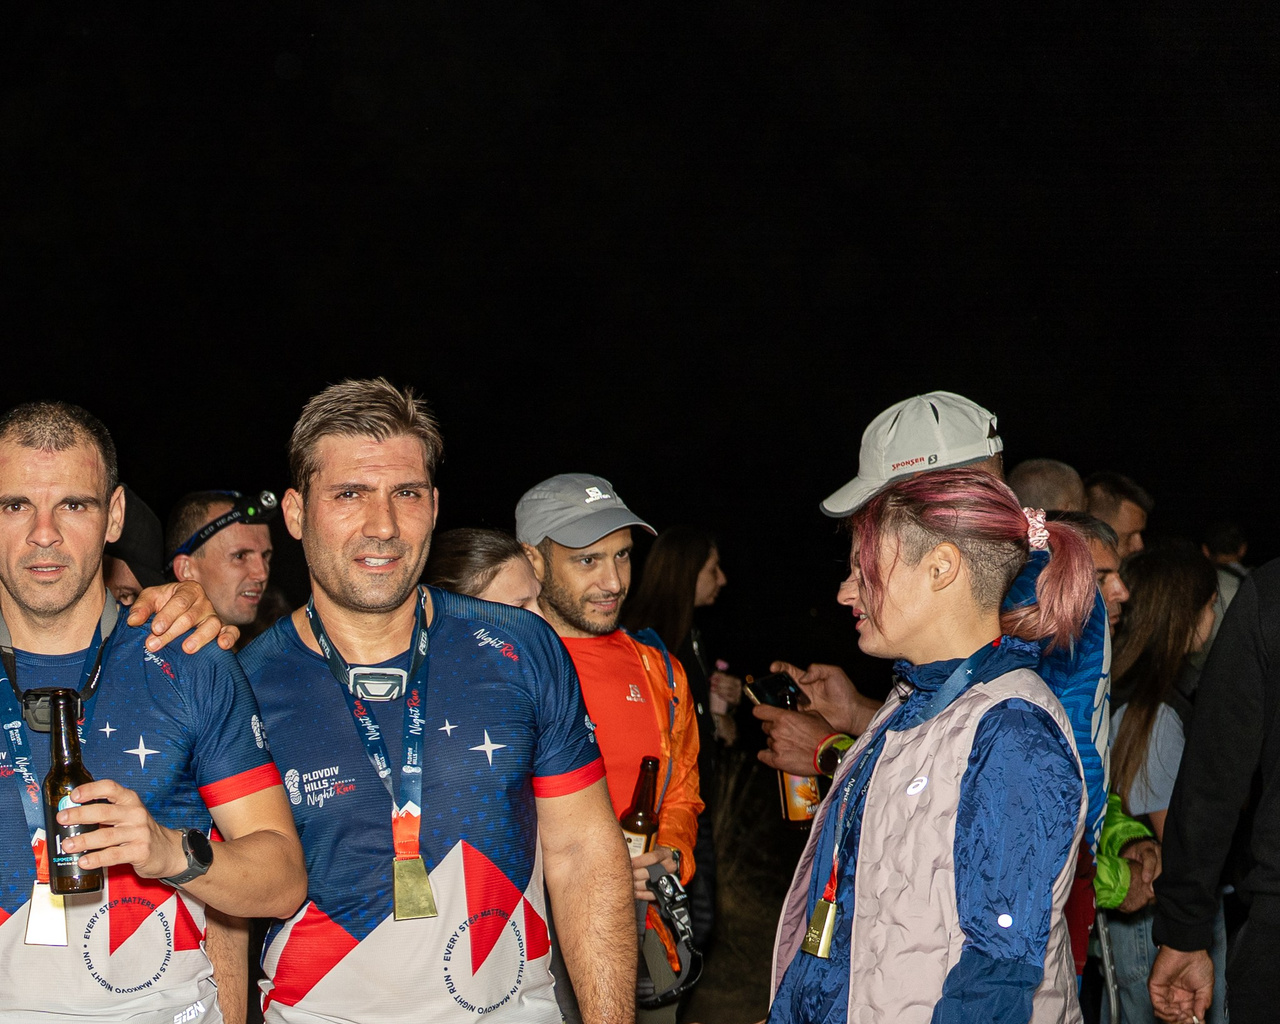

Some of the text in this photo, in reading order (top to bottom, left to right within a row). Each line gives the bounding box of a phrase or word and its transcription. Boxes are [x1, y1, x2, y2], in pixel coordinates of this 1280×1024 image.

[891, 456, 925, 471] SPONSER
[473, 628, 519, 662] Night Run
[353, 700, 381, 741] Night Run
[406, 689, 426, 735] Night Run
[13, 756, 40, 804] Night Run
[302, 766, 339, 783] PLOVDIV
[304, 779, 329, 793] HILLS
[307, 782, 356, 808] Night Run
[458, 914, 479, 932] STEP
[83, 897, 172, 994] EVERY STEP MATTERS PLOVDIV HILLS IN MARKOVO NIGHT RUN
[443, 931, 460, 962] EVERY
[510, 921, 525, 957] PLOVDIV
[444, 974, 457, 994] RUN
[516, 960, 524, 985] HILLS
[510, 985, 519, 996] IN
[453, 996, 476, 1012] NIGHT
